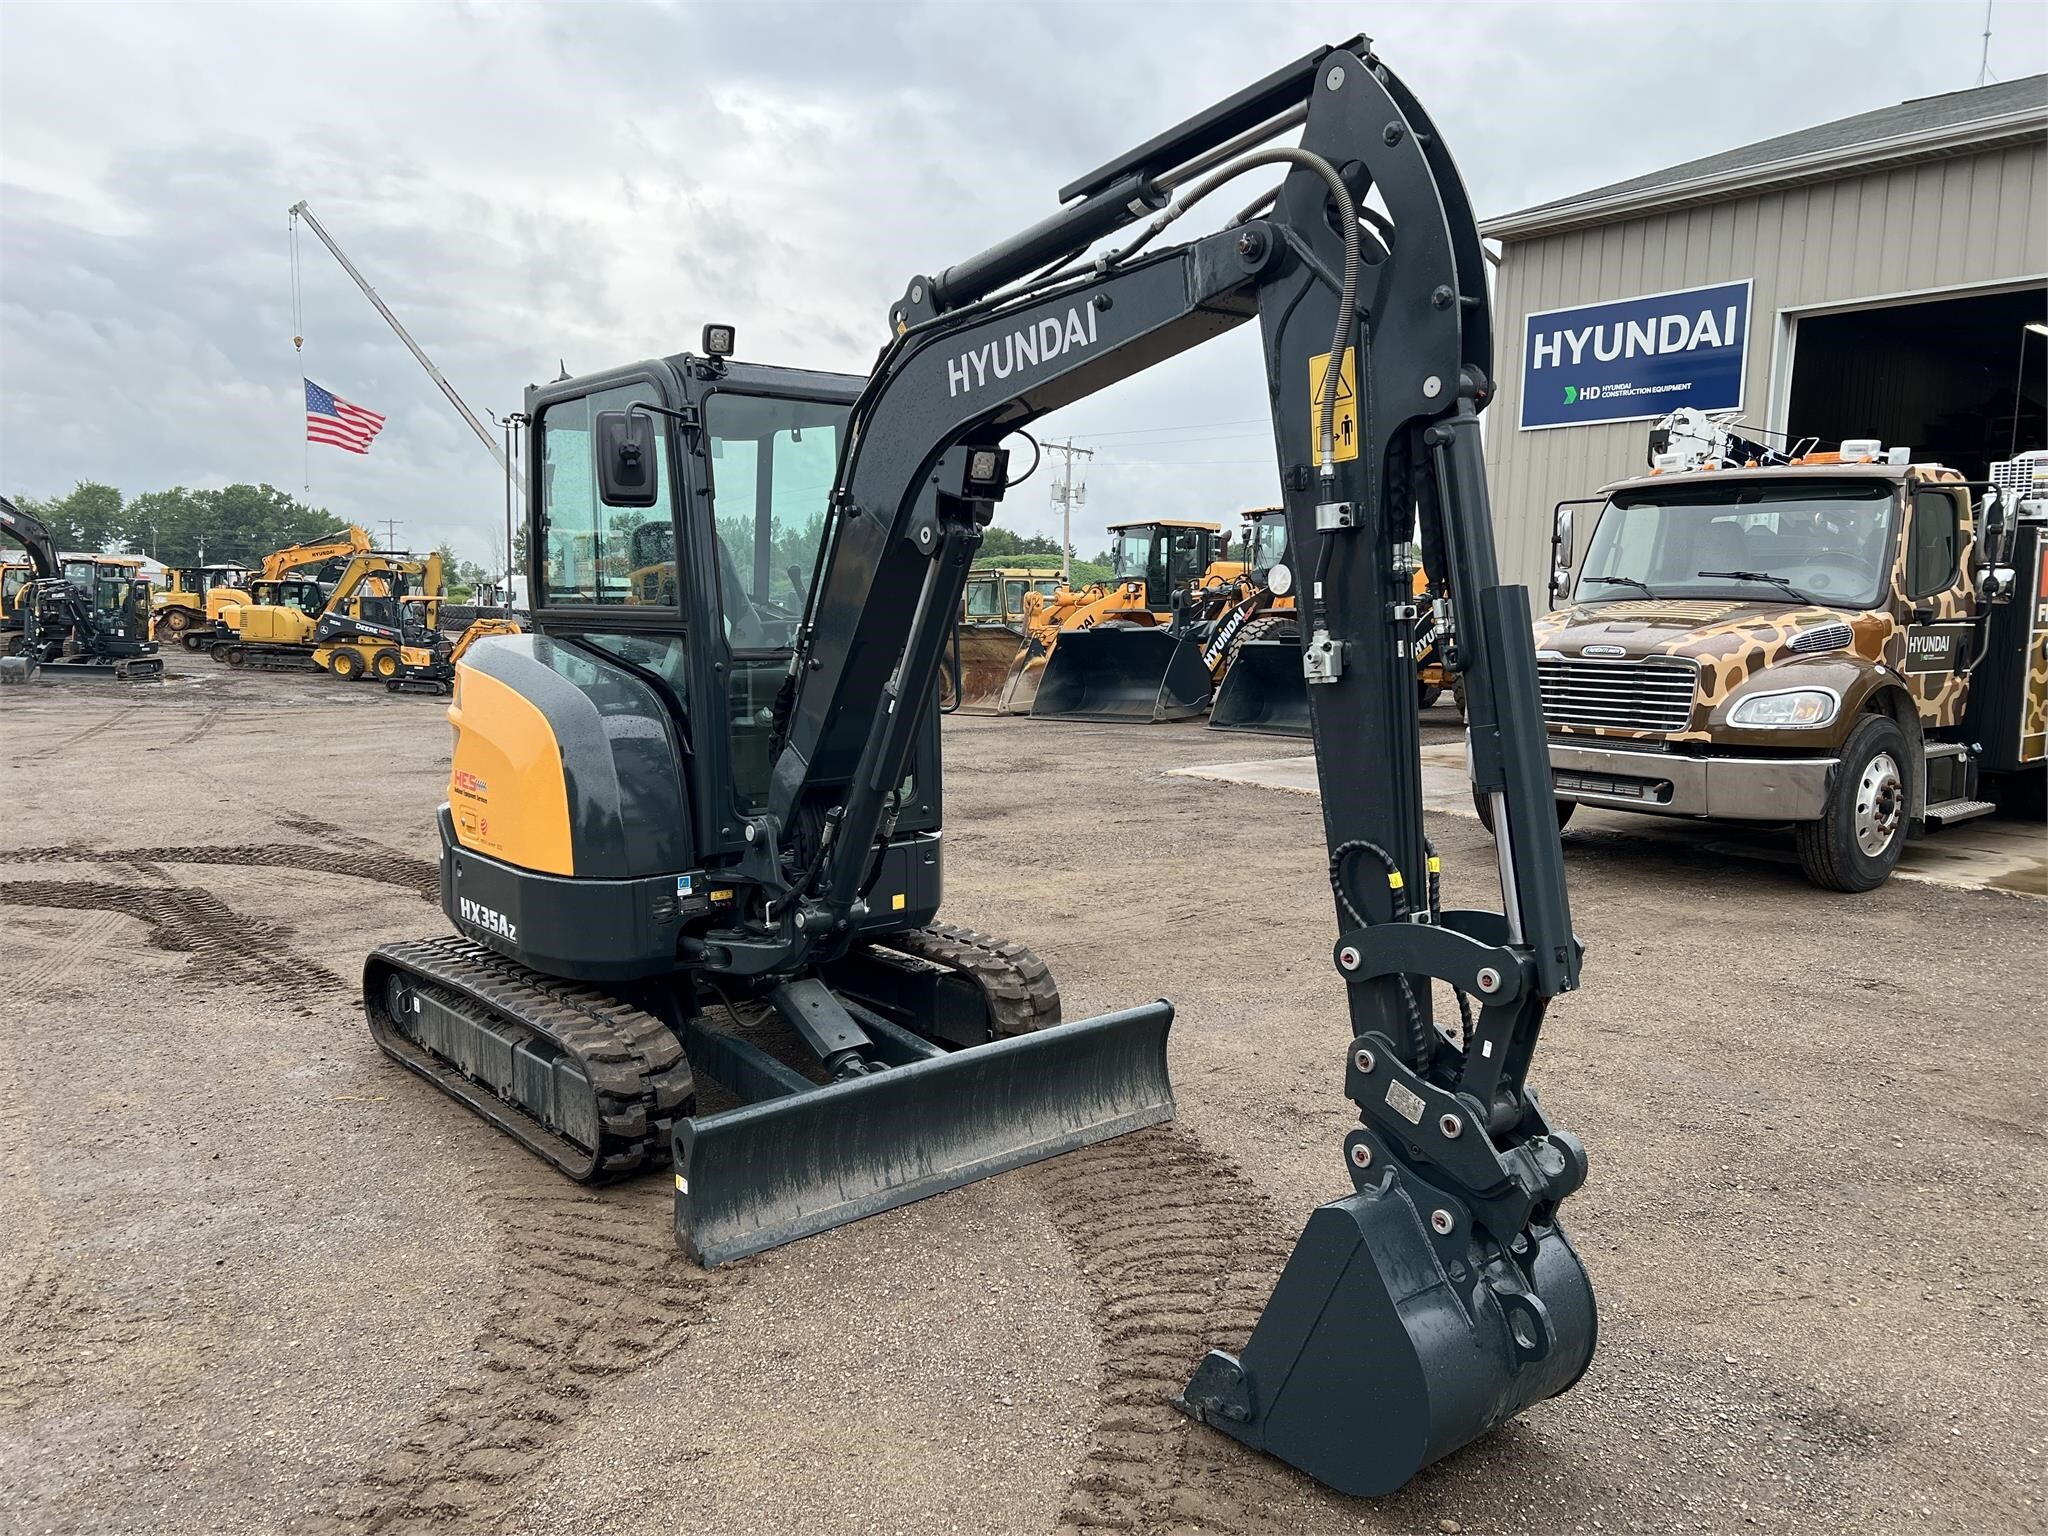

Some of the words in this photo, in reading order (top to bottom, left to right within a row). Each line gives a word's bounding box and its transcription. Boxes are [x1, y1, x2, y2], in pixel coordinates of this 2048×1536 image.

[1533, 306, 1737, 369] HYUNDAI
[947, 300, 1097, 397] HYUNDAI
[1580, 386, 1601, 400] HD
[1601, 387, 1652, 398] CONSTRUCTION
[1652, 382, 1692, 394] EQUIPMENT
[1602, 382, 1632, 392] HYUNDAI
[355, 622, 379, 634] DEERE
[1203, 606, 1246, 669] HYUNDAI
[1908, 635, 1950, 653] HYUNDAI
[454, 769, 477, 792] HES
